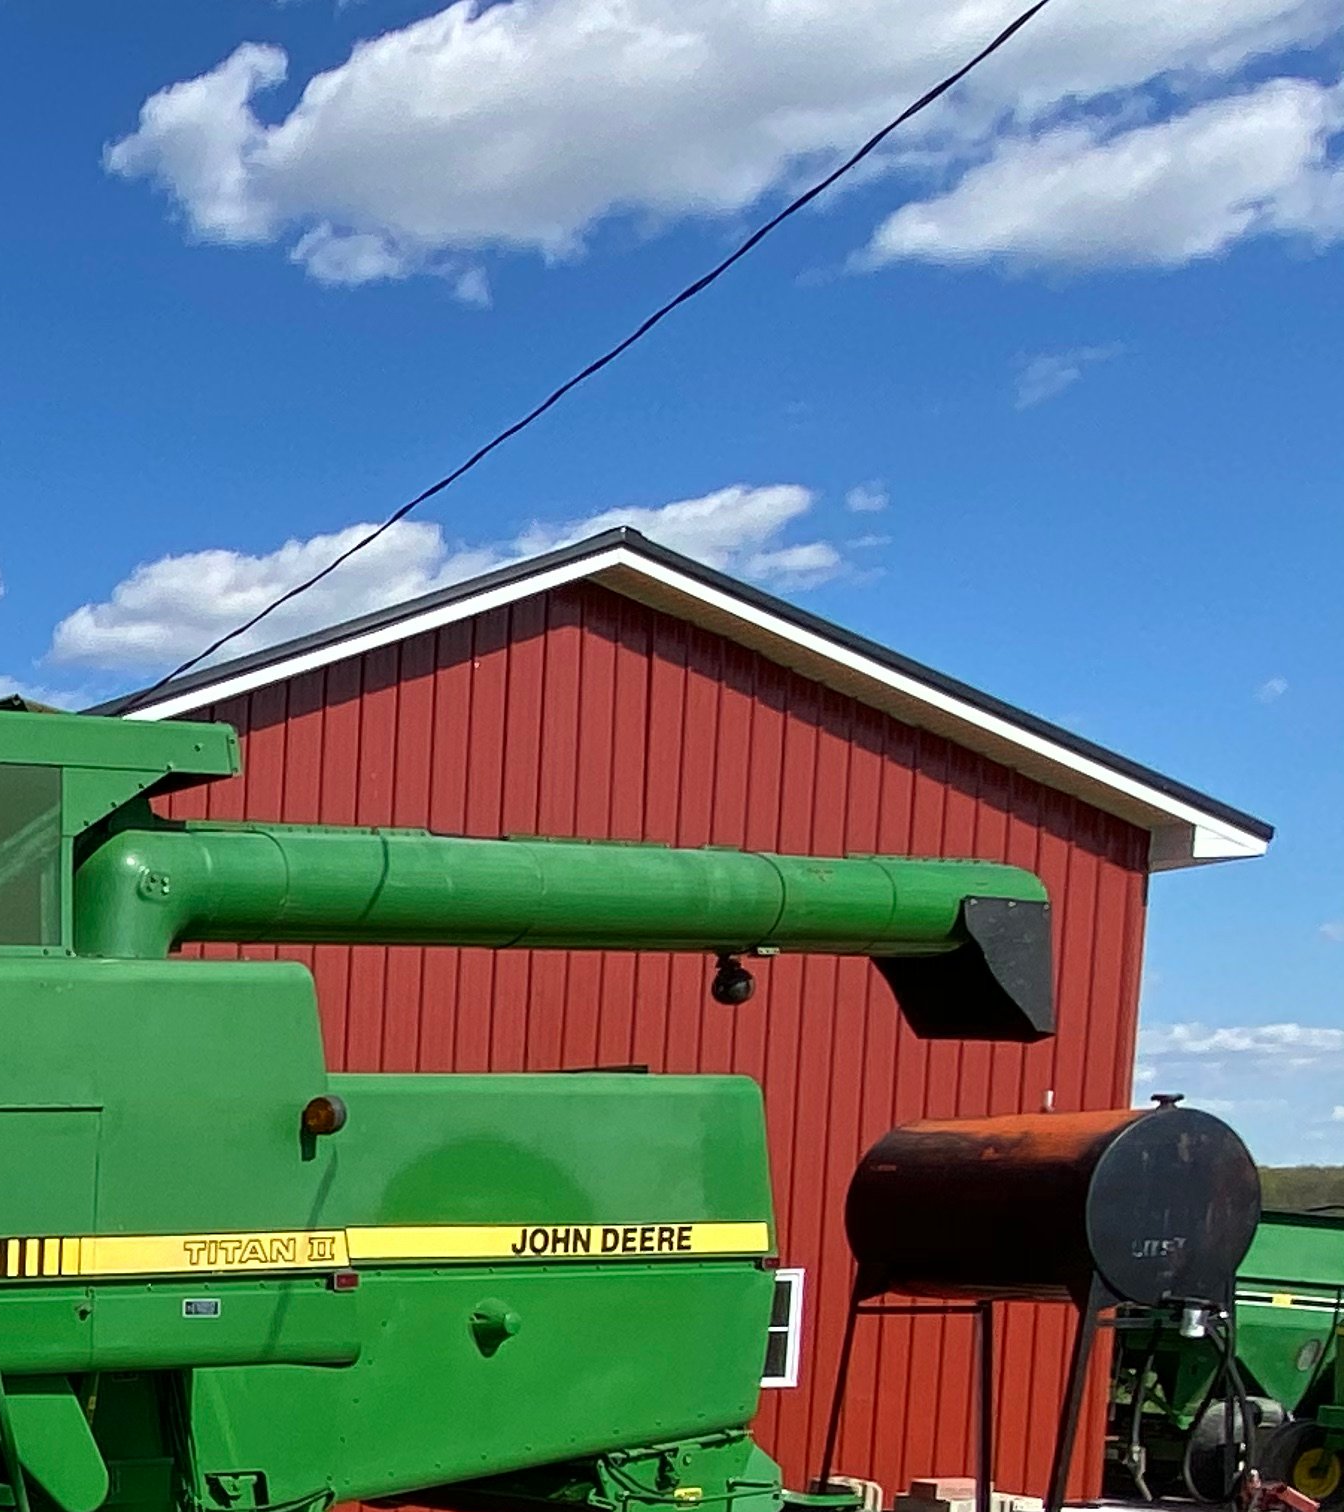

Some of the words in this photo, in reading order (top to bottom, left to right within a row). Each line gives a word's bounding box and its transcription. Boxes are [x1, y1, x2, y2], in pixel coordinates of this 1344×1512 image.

[183, 1238, 297, 1266] TITAN
[511, 1227, 591, 1255] JOHN
[600, 1226, 692, 1253] DEERE
